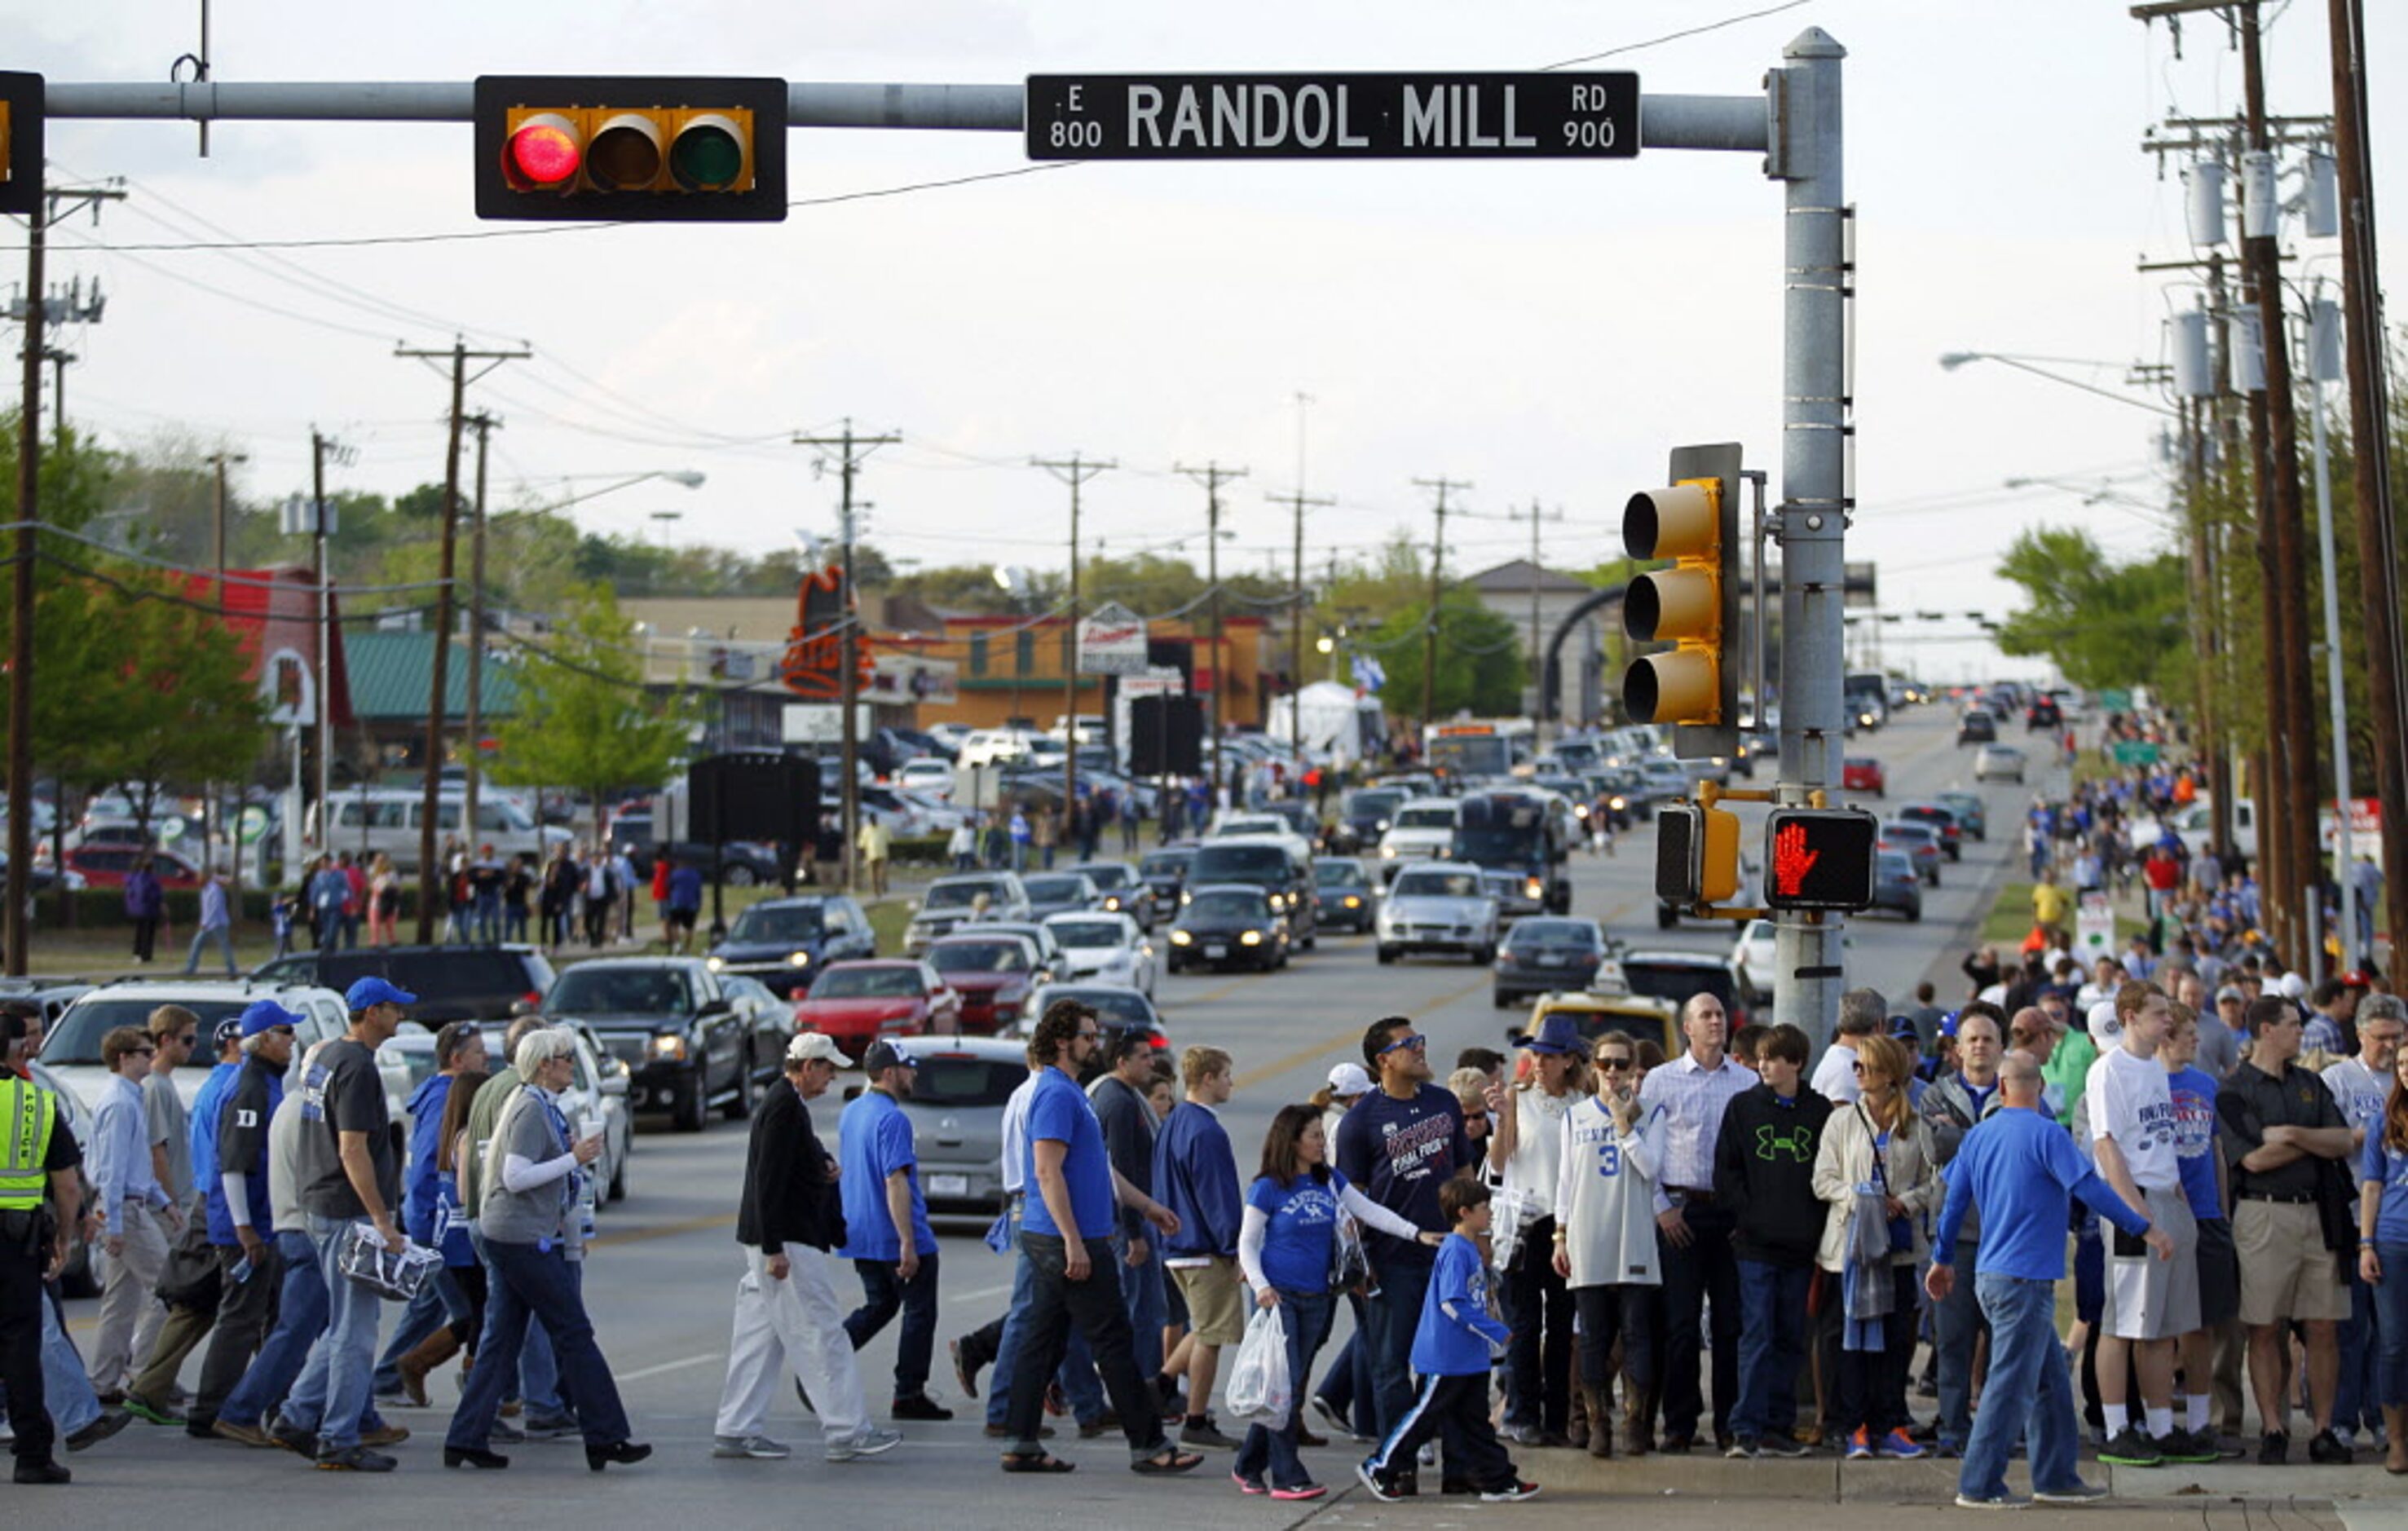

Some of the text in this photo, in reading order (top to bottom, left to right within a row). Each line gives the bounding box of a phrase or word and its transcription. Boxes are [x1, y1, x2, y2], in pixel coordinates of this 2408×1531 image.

[1069, 85, 1083, 112] E
[1572, 85, 1606, 111] RD
[1128, 84, 1537, 148] RANDOL MILL
[1050, 121, 1102, 148] 800
[1563, 121, 1615, 148] 900
[21, 1094, 34, 1158] POLICE
[236, 1108, 258, 1127] D
[1598, 1144, 1619, 1177] 3
[1281, 1189, 1335, 1215] KENTUCK
